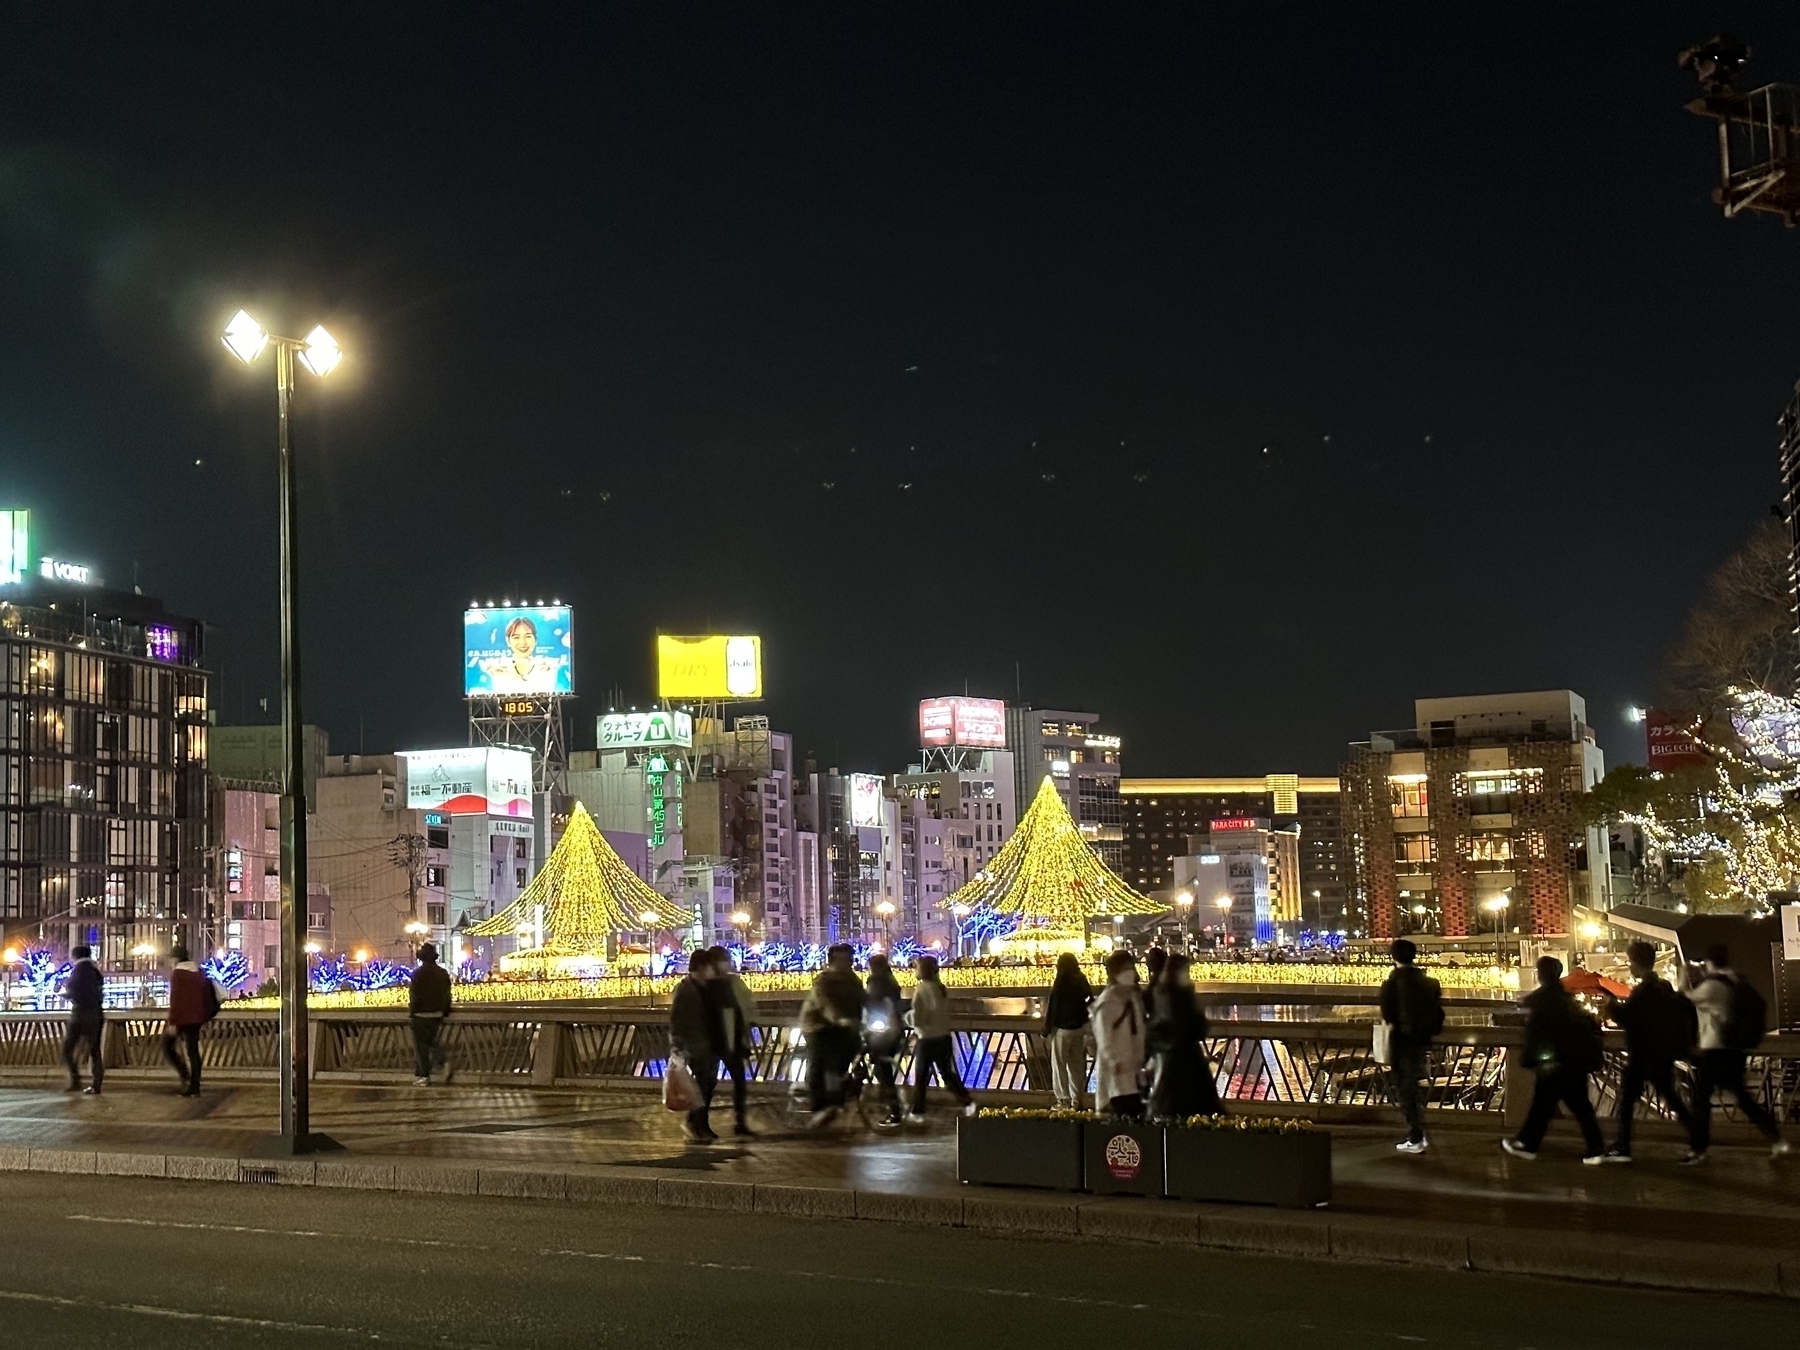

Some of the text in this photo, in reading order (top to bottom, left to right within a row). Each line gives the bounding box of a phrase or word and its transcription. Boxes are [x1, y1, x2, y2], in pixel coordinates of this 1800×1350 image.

[54, 562, 88, 582] VORT
[603, 720, 642, 731] ウチヤマ
[603, 730, 643, 743] グループ
[1651, 745, 1672, 756] BIG
[420, 782, 472, 796] 福一不動産
[652, 775, 665, 845] 内山第45ビル
